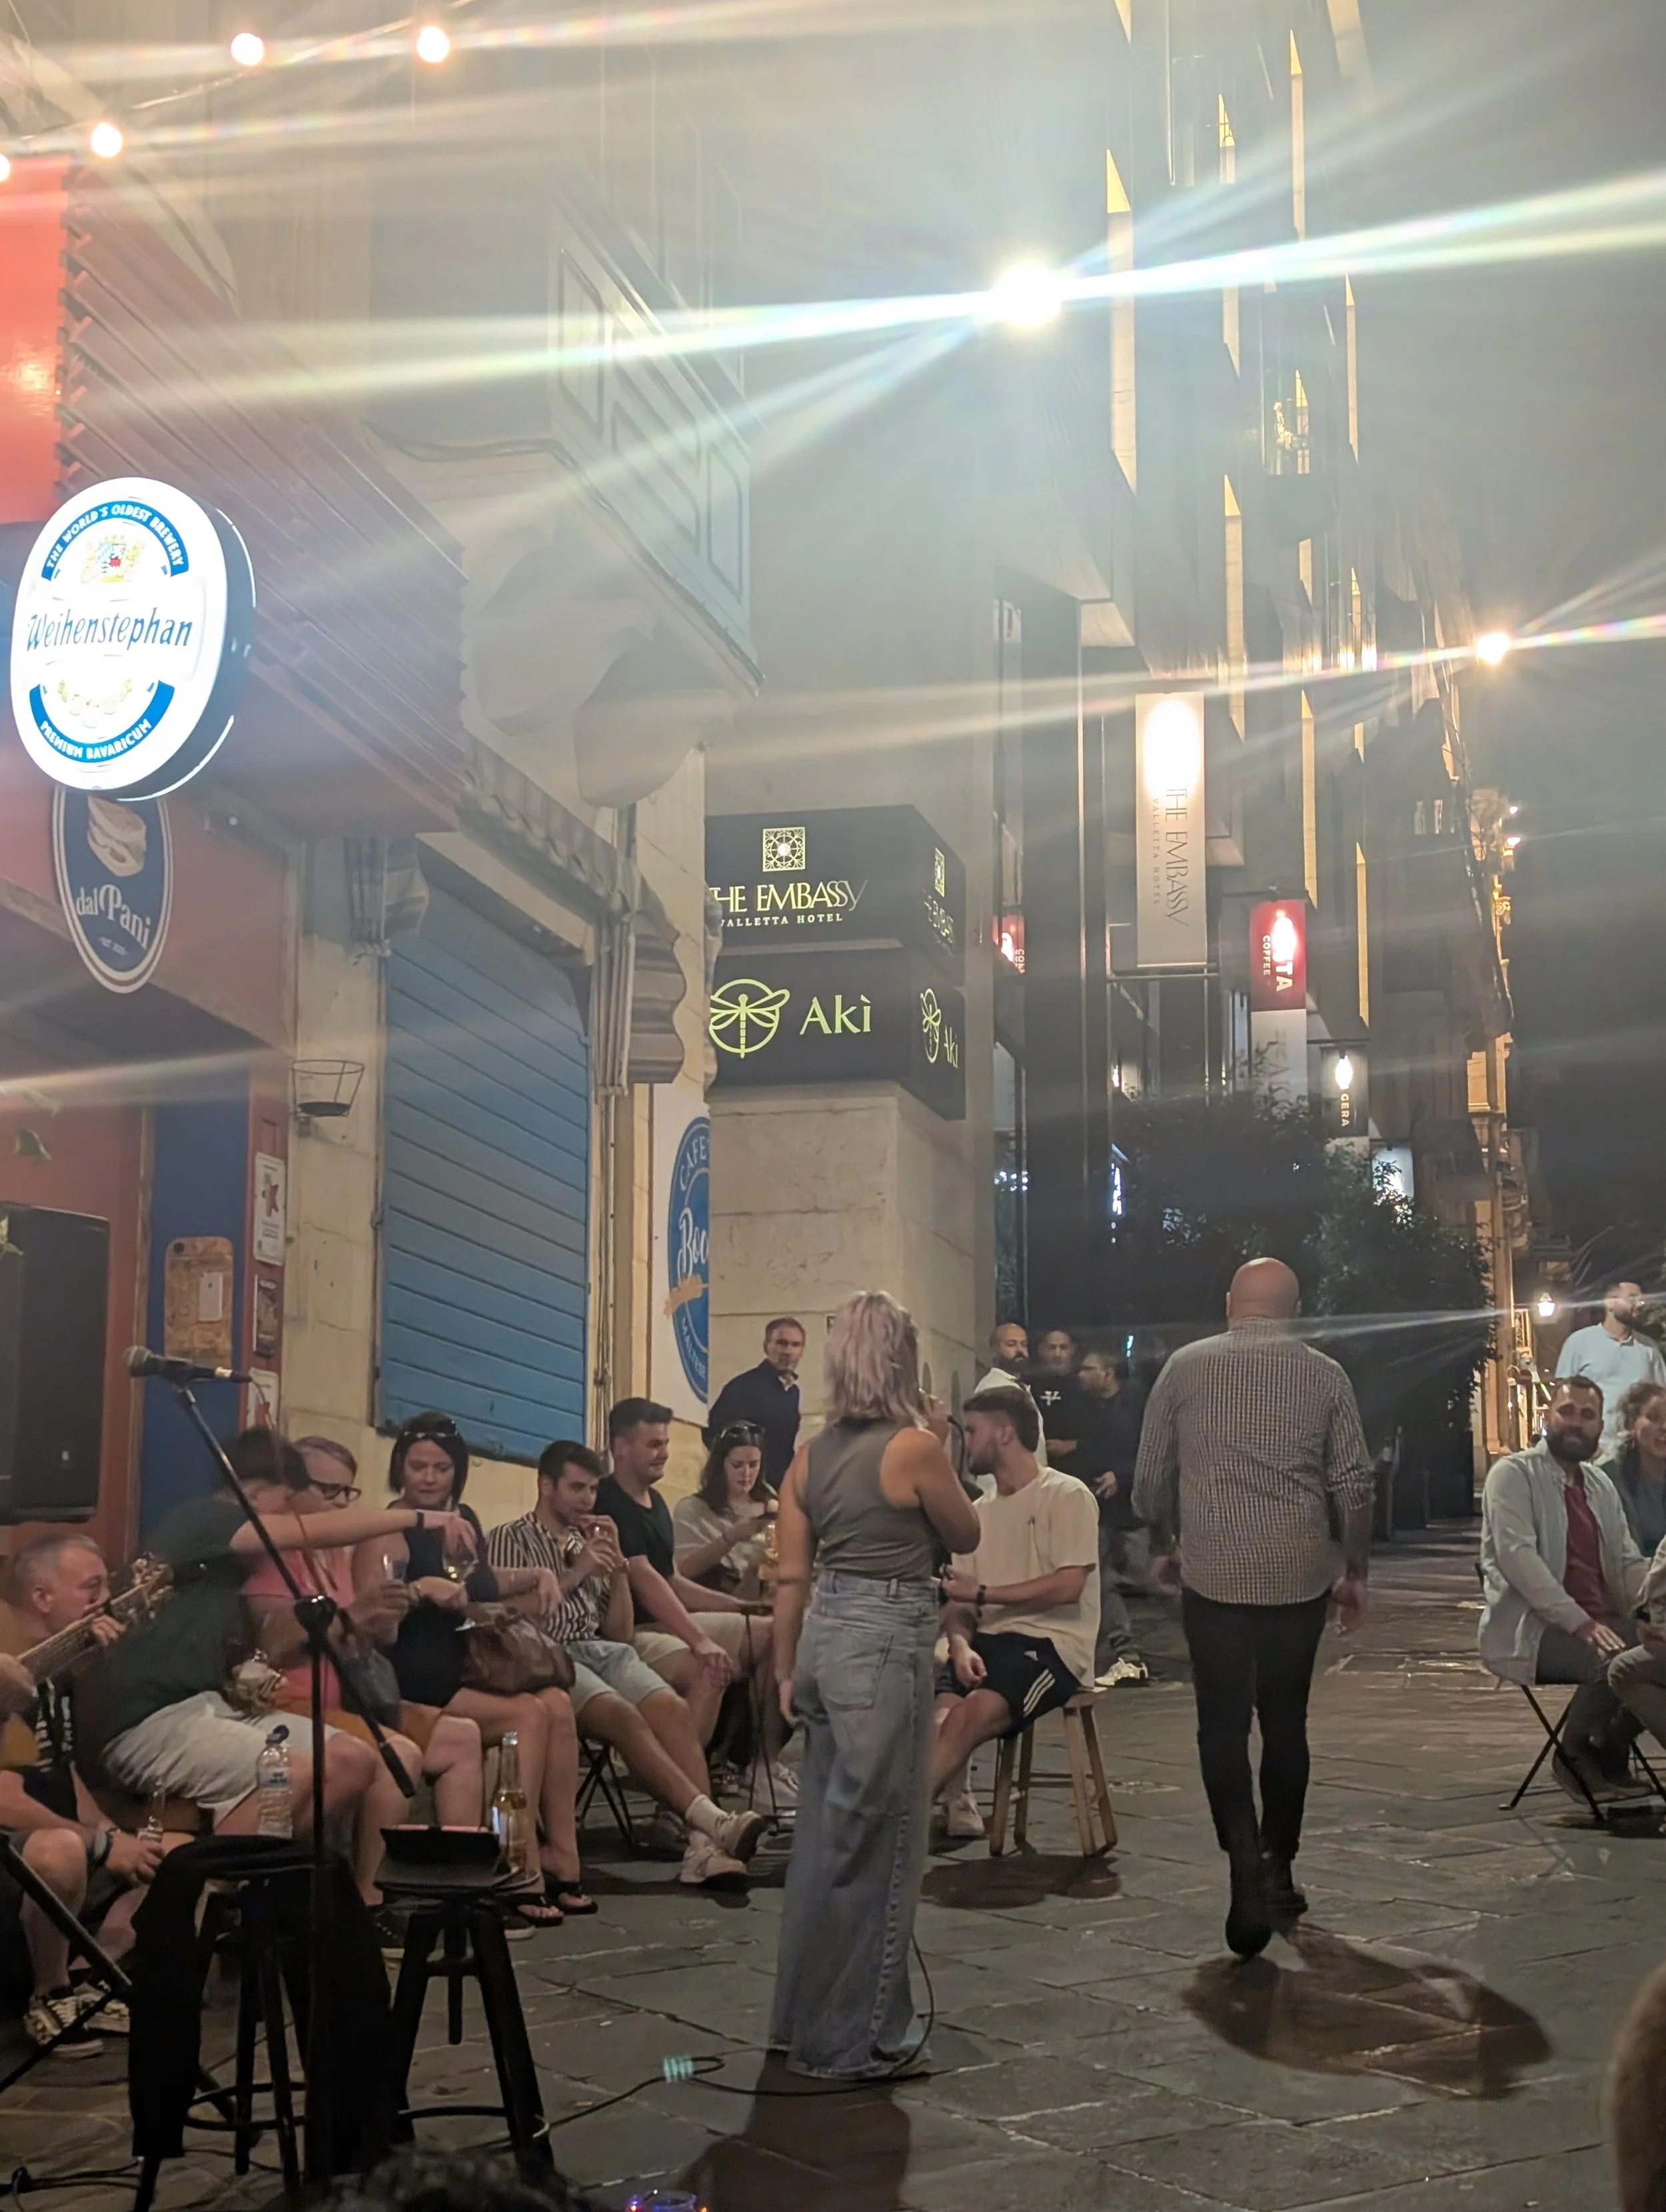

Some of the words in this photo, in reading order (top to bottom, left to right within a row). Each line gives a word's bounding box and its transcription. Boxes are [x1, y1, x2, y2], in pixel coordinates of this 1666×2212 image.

[46, 543, 64, 568] THE
[62, 506, 109, 543] WORLD'S
[111, 504, 153, 522] OLDEST
[149, 516, 185, 566] BREWERY
[27, 607, 193, 652] Weihenstephan
[40, 720, 84, 759] PREMIUM
[86, 718, 152, 760] BAVARICUM
[1166, 788, 1188, 822] THE
[709, 885, 748, 913] THE
[756, 879, 868, 913] EMBASSY
[1164, 831, 1190, 927] EMBASSY
[796, 913, 844, 924] HOTEL
[1262, 935, 1271, 976] COFFEE
[799, 994, 872, 1035] Akì
[680, 1135, 710, 1191] CAFE
